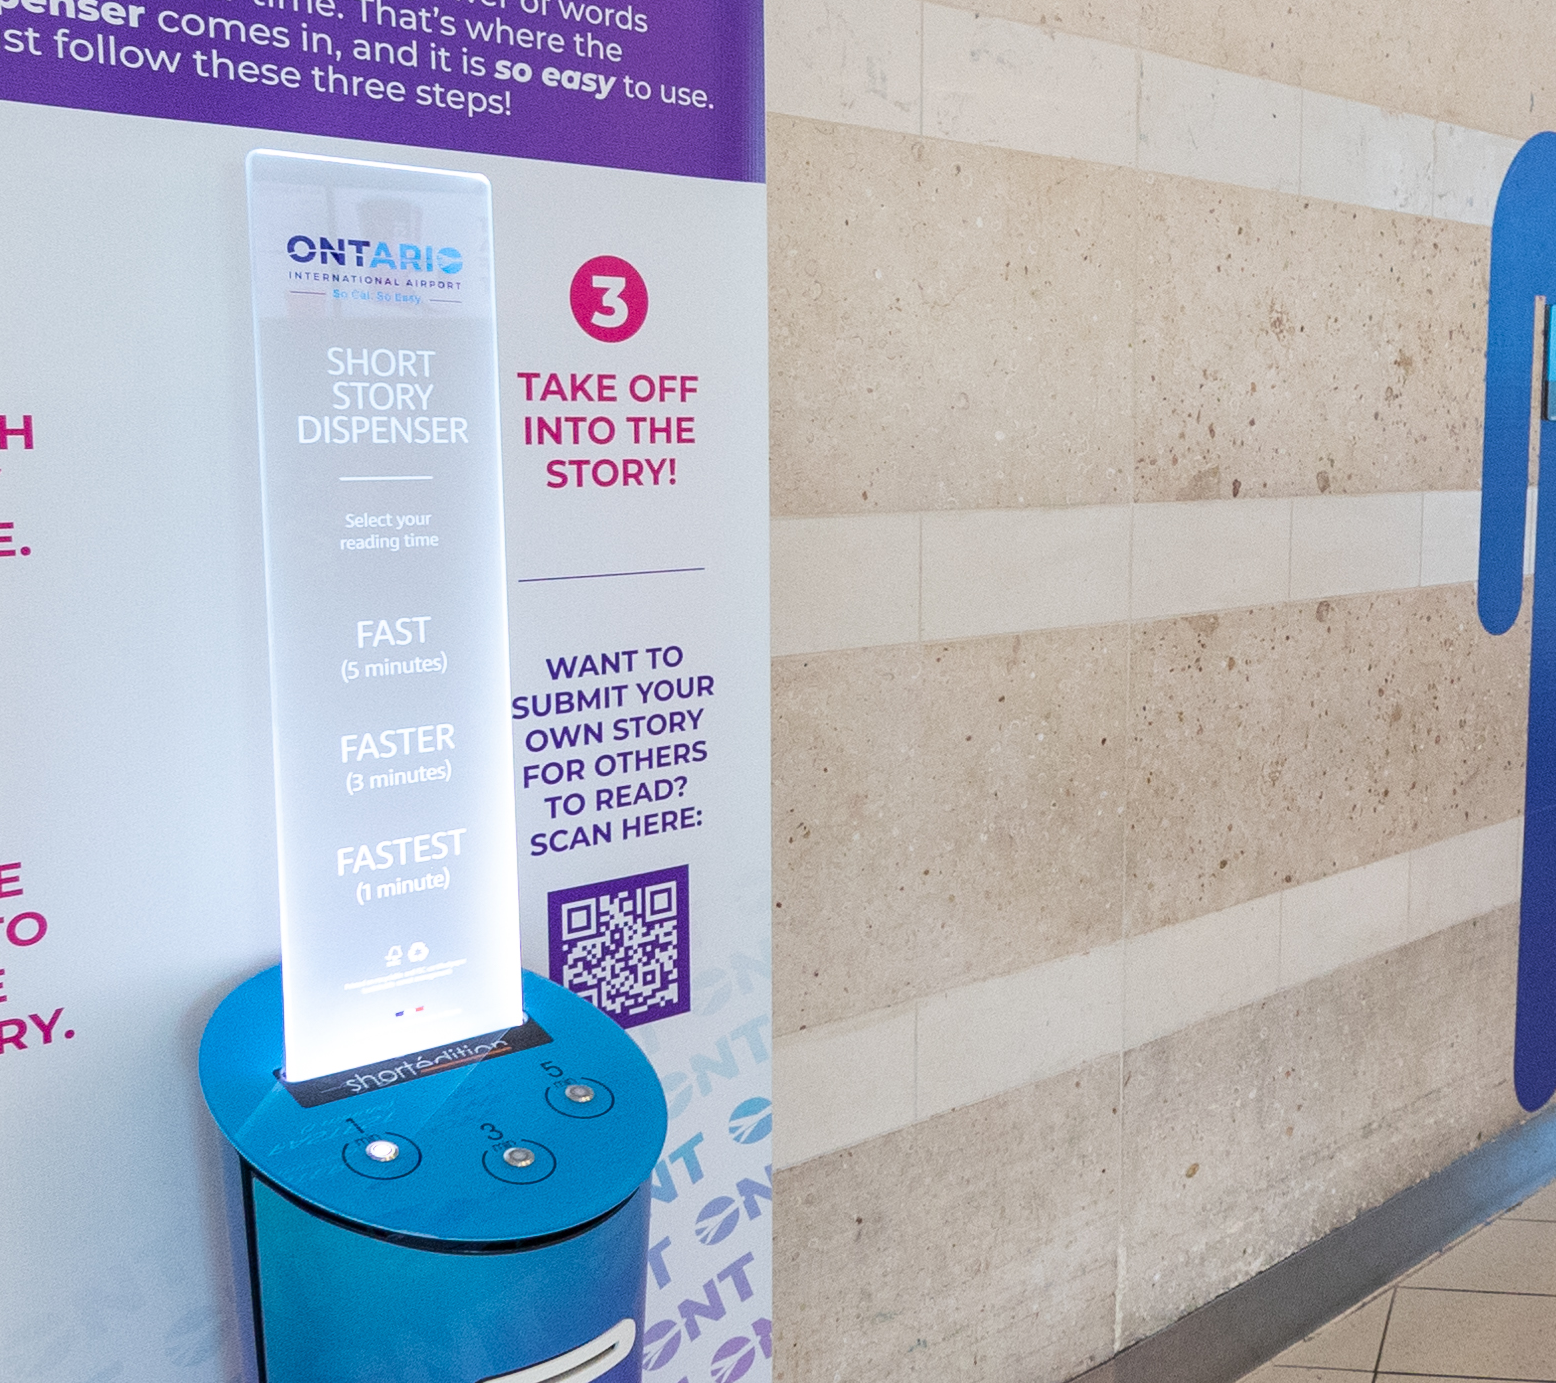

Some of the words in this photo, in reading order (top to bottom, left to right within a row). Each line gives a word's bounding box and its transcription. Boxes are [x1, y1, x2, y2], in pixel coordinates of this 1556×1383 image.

[558, 0, 648, 32] words
[465, 17, 564, 53] where
[573, 33, 622, 62] the
[54, 28, 181, 72] follow
[193, 49, 301, 88] these
[311, 65, 405, 102] three
[416, 83, 510, 117] steps!
[158, 11, 290, 48] comes
[302, 31, 341, 61] in,
[353, 39, 417, 67] and
[431, 48, 451, 72] it
[463, 55, 486, 76] is
[494, 60, 532, 82] so
[542, 67, 616, 99] easy
[623, 76, 651, 100] to
[661, 85, 713, 109] use.
[287, 235, 463, 274] ONTARIO
[289, 272, 399, 286] INTERNATIONAL
[405, 279, 460, 289] AIRPORT
[333, 289, 348, 299] So
[376, 292, 391, 301] So
[592, 276, 628, 327] 3
[327, 347, 435, 377] SHORT
[333, 382, 433, 410] STORY
[517, 372, 617, 401] TAKE
[629, 375, 698, 402] OFF
[298, 416, 469, 444] DISPENSER
[525, 416, 615, 445] INTO
[626, 417, 695, 444] THE
[547, 458, 675, 488] STORY!
[345, 513, 392, 528] Select
[396, 513, 432, 533] your
[340, 534, 399, 551] reading
[404, 533, 439, 547] time
[357, 617, 431, 648] FAST
[341, 660, 359, 683] (5
[365, 651, 447, 677] minutes)
[546, 650, 638, 680] WANT
[646, 646, 683, 669] TO
[512, 685, 626, 720] SUBMIT
[636, 675, 714, 703] YOUR
[341, 724, 455, 763] FASTER
[526, 722, 602, 752] OWN
[613, 708, 703, 740] STORY
[346, 772, 364, 795] (3
[370, 759, 452, 789] minutes)
[524, 759, 584, 788] FOR
[595, 741, 707, 776] OTHERS
[544, 793, 585, 818] TO
[596, 776, 687, 811] READ?
[531, 822, 611, 856] SCAN
[623, 807, 702, 840] HERE:
[337, 828, 467, 876] FASTEST
[356, 882, 371, 905] (1
[377, 867, 450, 898] minute)
[540, 1060, 563, 1078] 5
[480, 1122, 504, 1141] 3
